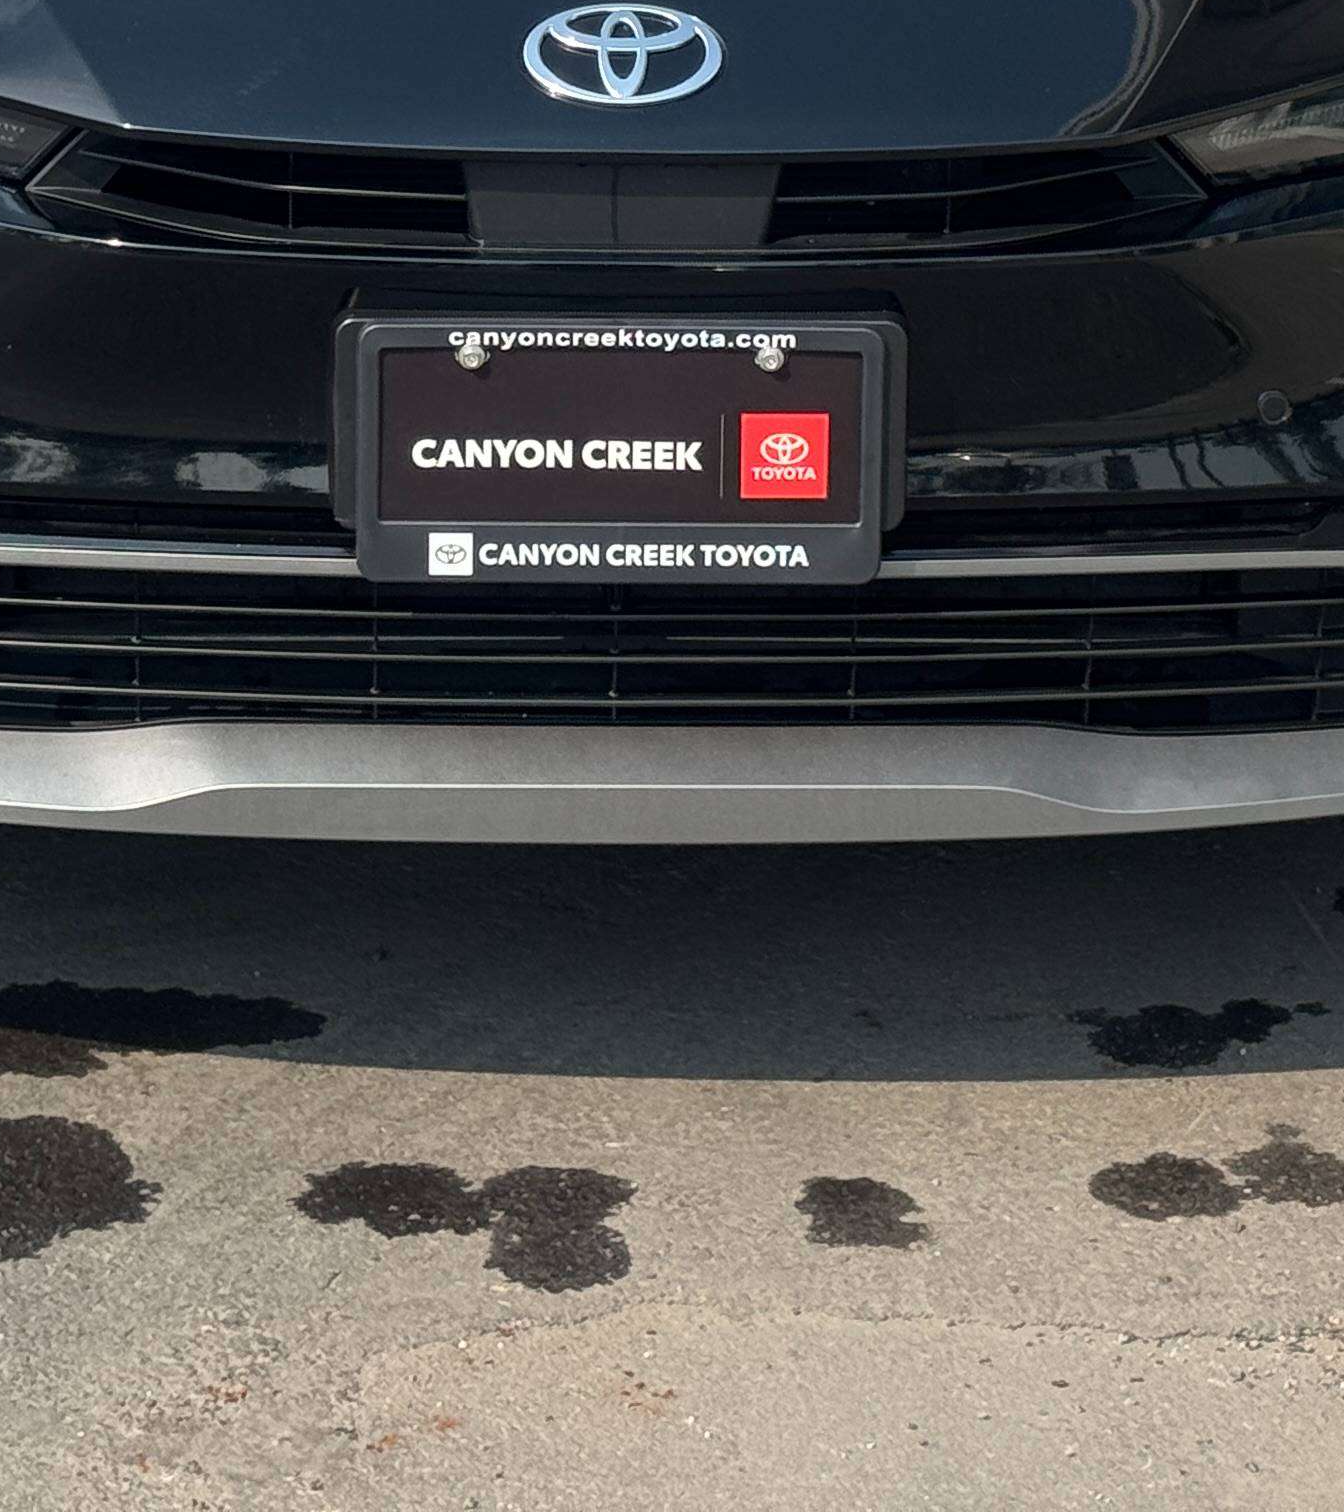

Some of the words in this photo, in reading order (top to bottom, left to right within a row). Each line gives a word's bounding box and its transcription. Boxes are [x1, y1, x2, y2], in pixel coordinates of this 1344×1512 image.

[447, 328, 798, 352] canyoncreektoyota.com
[411, 438, 575, 470] CANYON
[581, 439, 704, 472] CREEK
[751, 465, 817, 482] TOYOTA
[478, 542, 601, 568] CANYON
[605, 543, 695, 568] CREEK
[699, 543, 810, 569] TOYOTA
